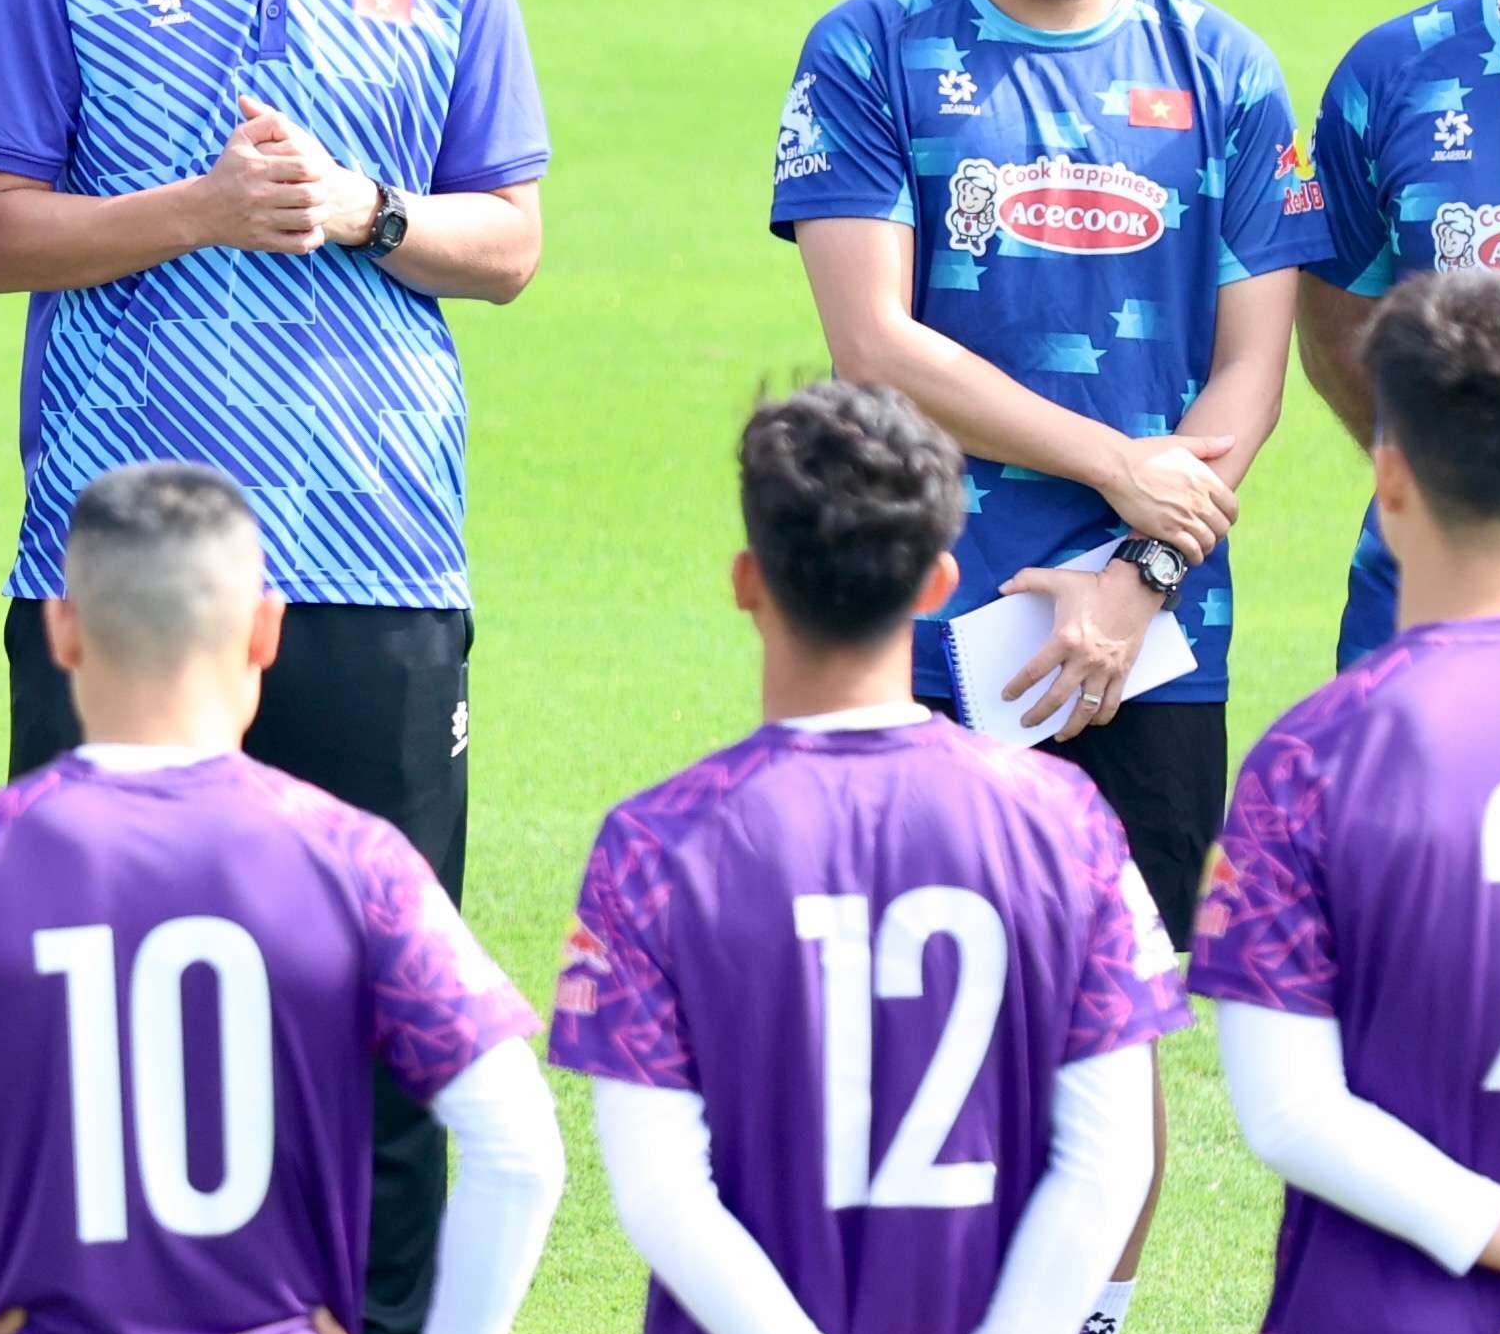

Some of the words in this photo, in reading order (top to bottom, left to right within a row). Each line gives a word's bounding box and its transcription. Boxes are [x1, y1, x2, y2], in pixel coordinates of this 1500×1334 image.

[775, 151, 832, 185] AIGON.
[1002, 161, 1051, 186] Cook
[1060, 163, 1164, 204] happiness
[32, 915, 276, 1244] 10
[793, 885, 1008, 1210] 12
